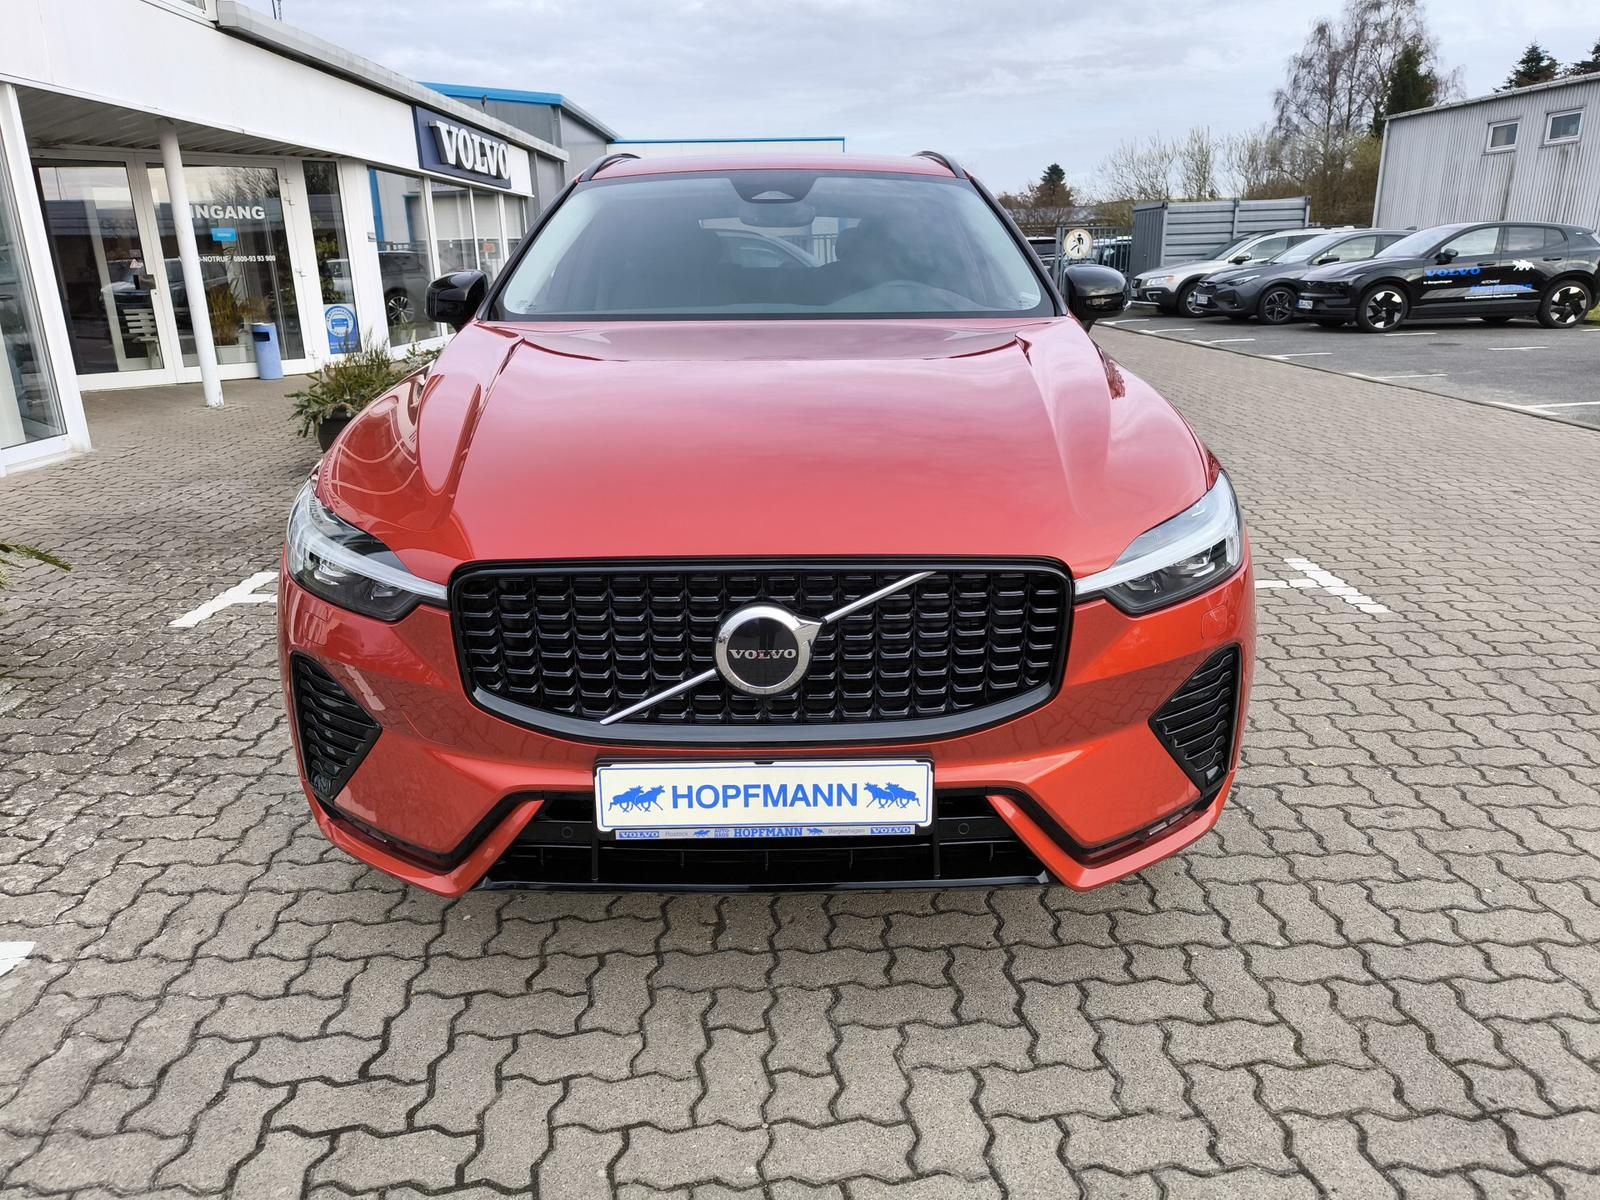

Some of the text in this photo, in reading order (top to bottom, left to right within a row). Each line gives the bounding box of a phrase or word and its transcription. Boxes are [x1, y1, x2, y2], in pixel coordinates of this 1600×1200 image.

[433, 120, 512, 180] VOLVO
[190, 204, 266, 220] INGANG
[1425, 267, 1481, 277] VOLVO
[728, 648, 797, 660] VOLVO
[671, 783, 858, 809] HOPFMANN
[734, 827, 803, 838] HOPFMANN
[871, 826, 911, 834] VOLVO
